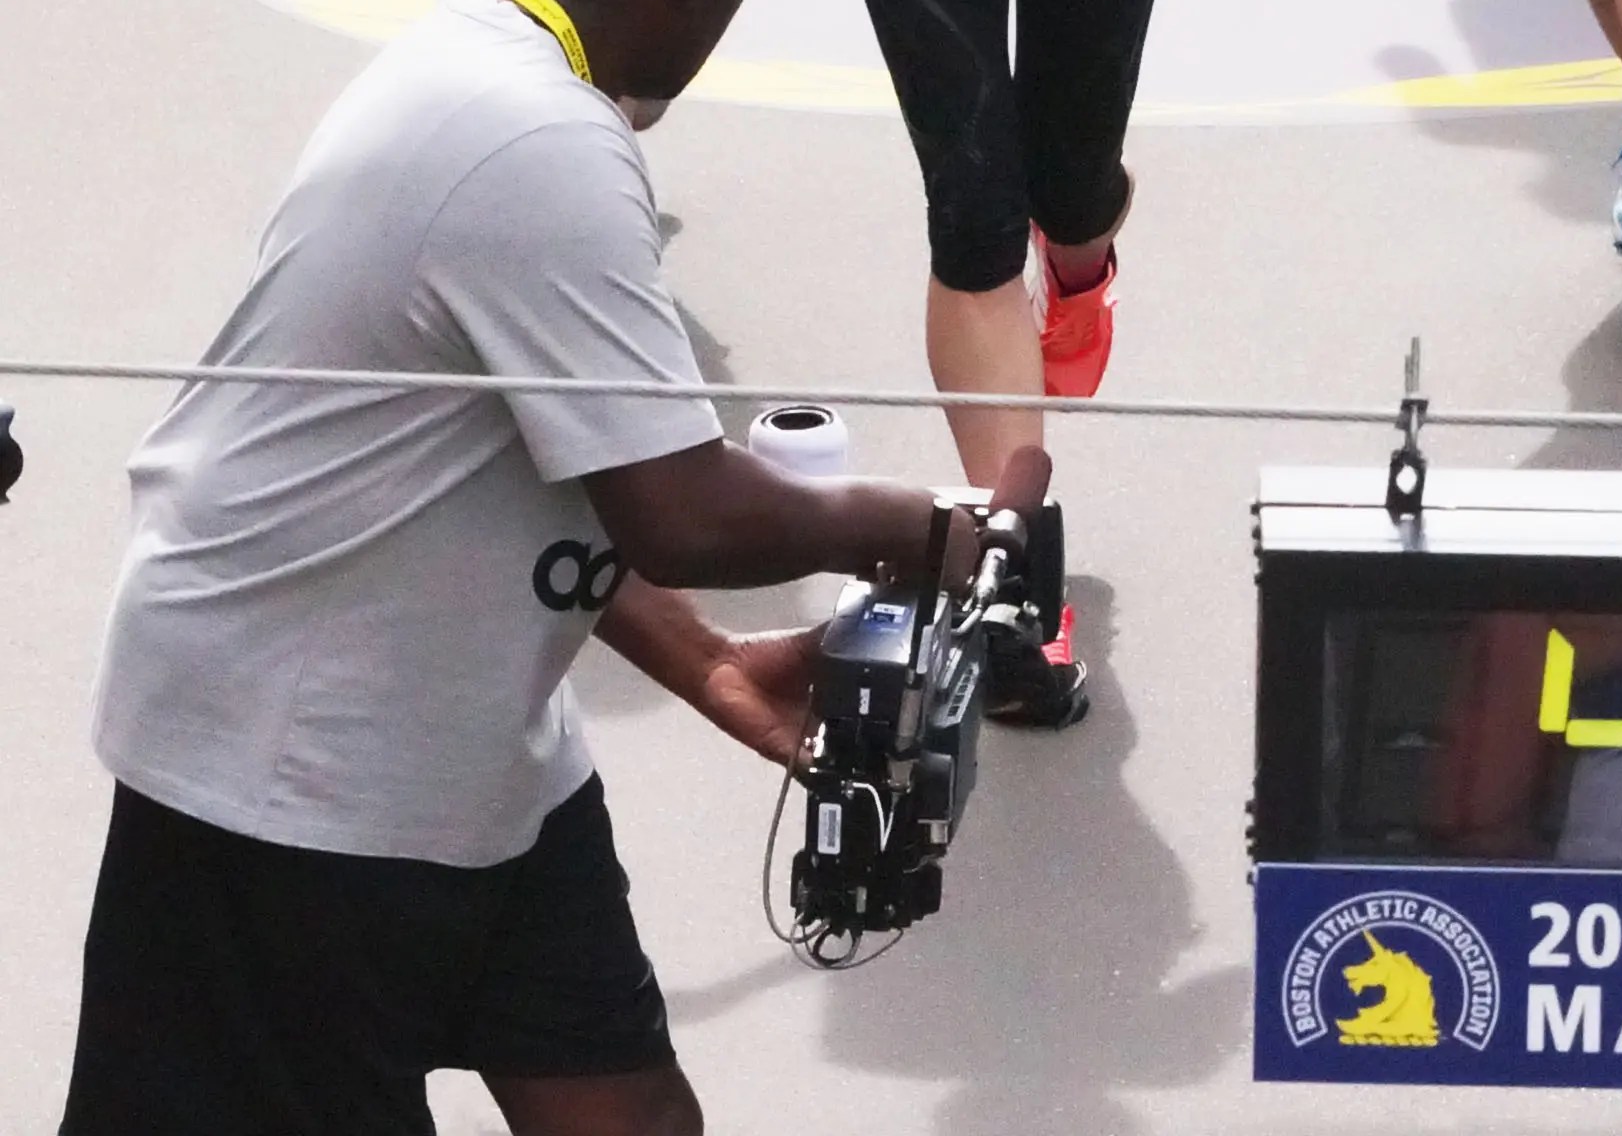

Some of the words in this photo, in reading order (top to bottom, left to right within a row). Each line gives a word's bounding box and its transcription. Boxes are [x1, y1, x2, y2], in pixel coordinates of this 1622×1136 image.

[1290, 947, 1322, 1033] BOSTON
[1312, 898, 1418, 950] ATHLETIC
[1419, 905, 1493, 1036] ASSOCIATION
